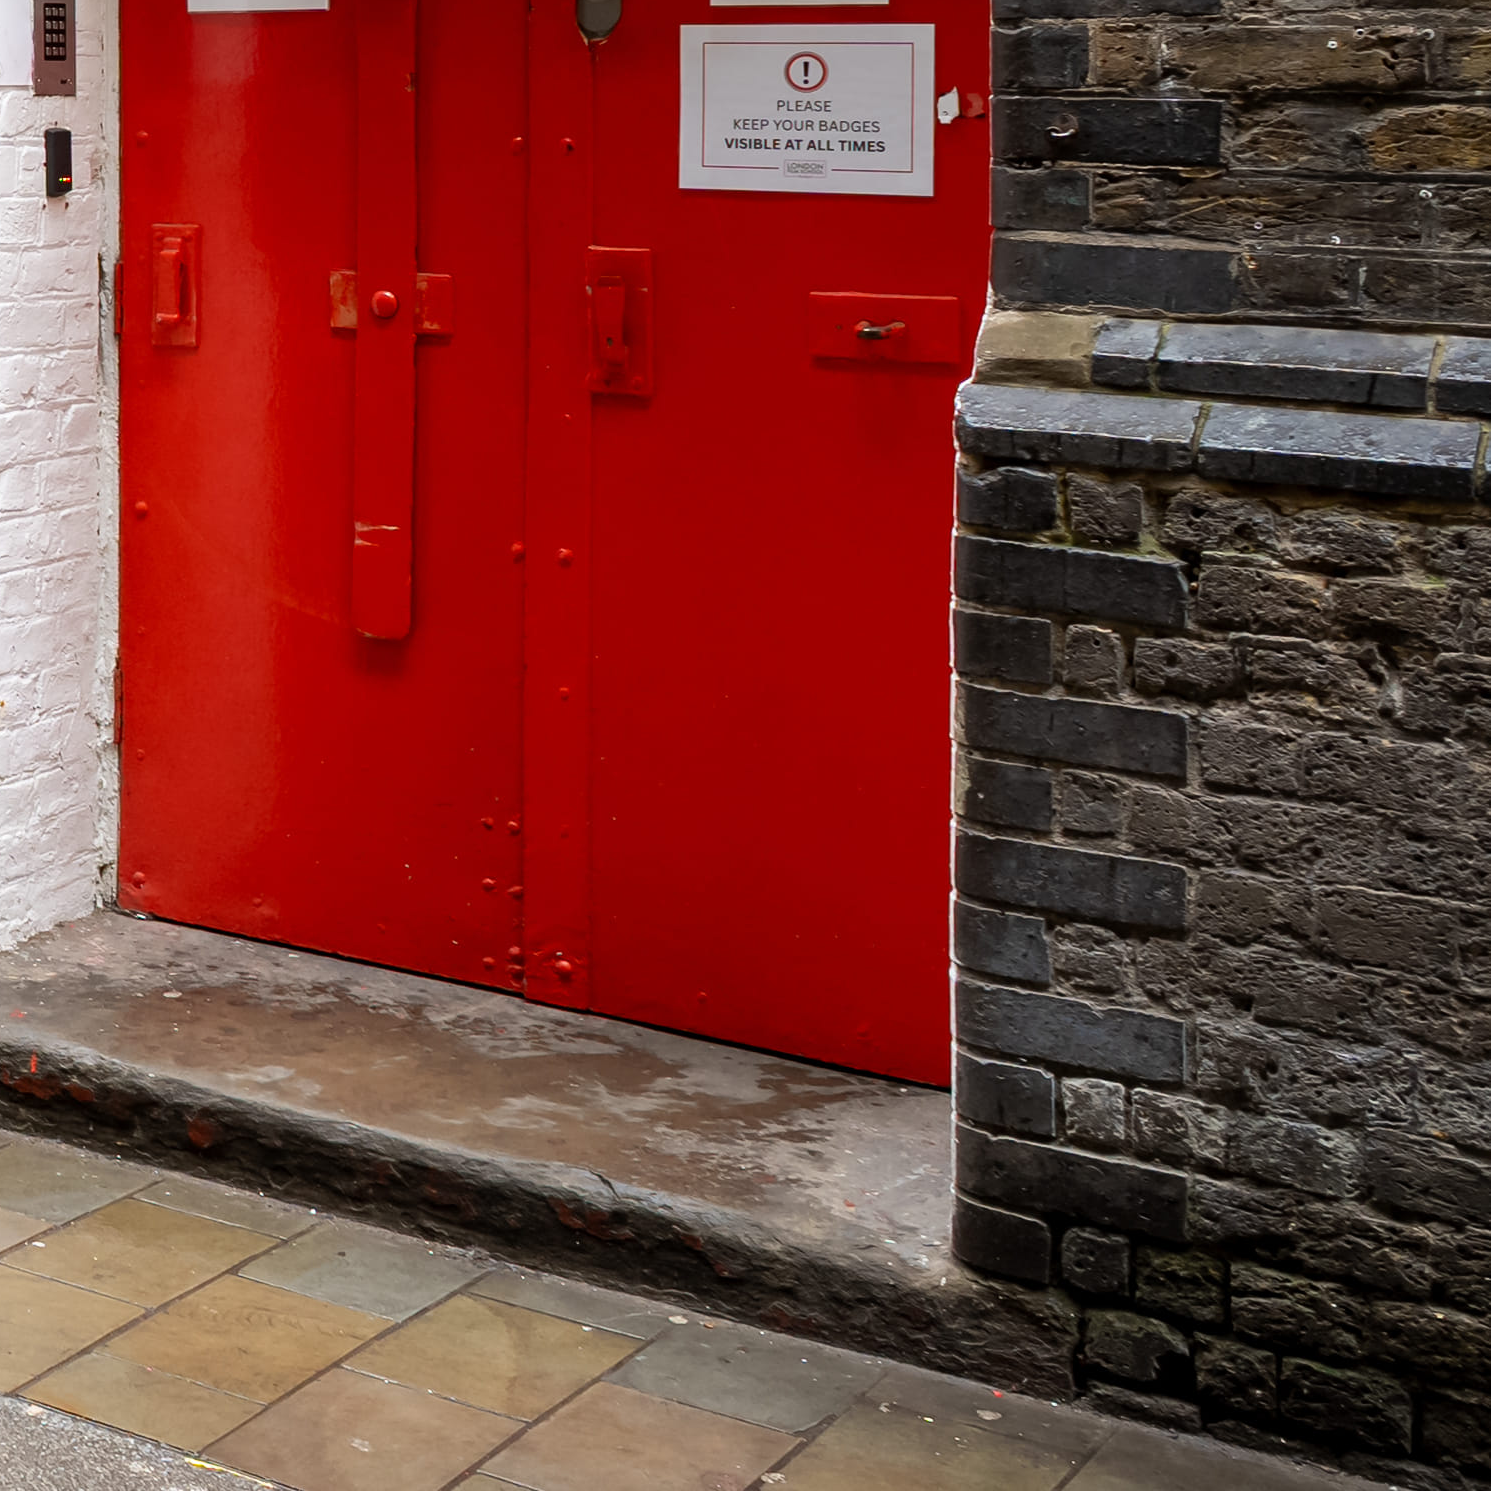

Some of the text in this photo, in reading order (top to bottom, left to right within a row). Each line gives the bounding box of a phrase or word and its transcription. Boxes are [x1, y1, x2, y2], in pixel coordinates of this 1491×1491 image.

[777, 100, 831, 112] PLEASE
[733, 119, 880, 133] KEEP YOUR BADGES
[725, 138, 885, 152] VISIBLE AT ALL TIMES
